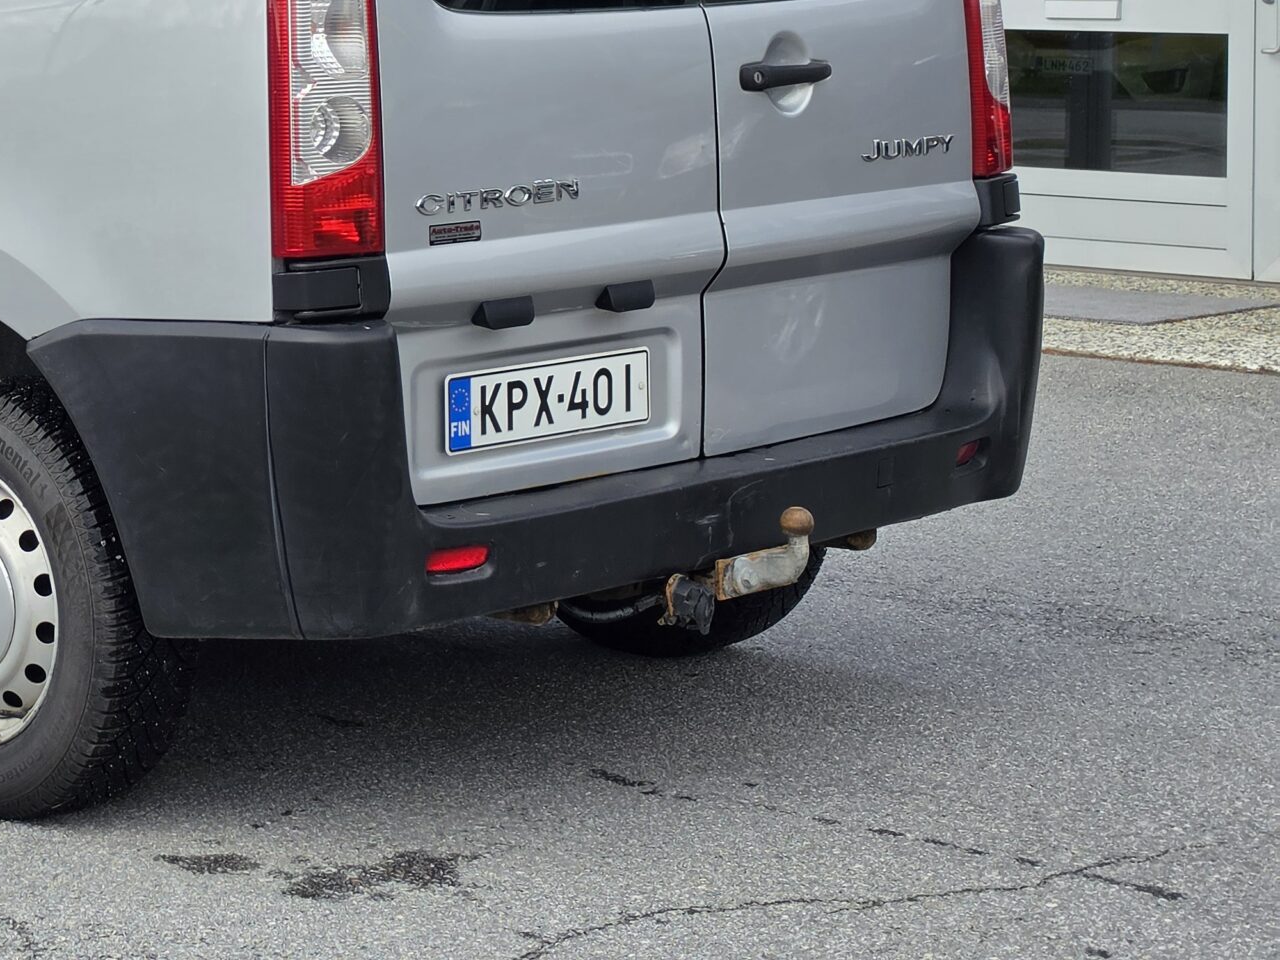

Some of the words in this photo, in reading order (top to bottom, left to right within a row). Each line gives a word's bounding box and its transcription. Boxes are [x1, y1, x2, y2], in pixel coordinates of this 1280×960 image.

[861, 134, 954, 162] JUMPY
[415, 178, 579, 216] CITROËN
[480, 364, 631, 436] KPX-401
[450, 420, 470, 438] FIN
